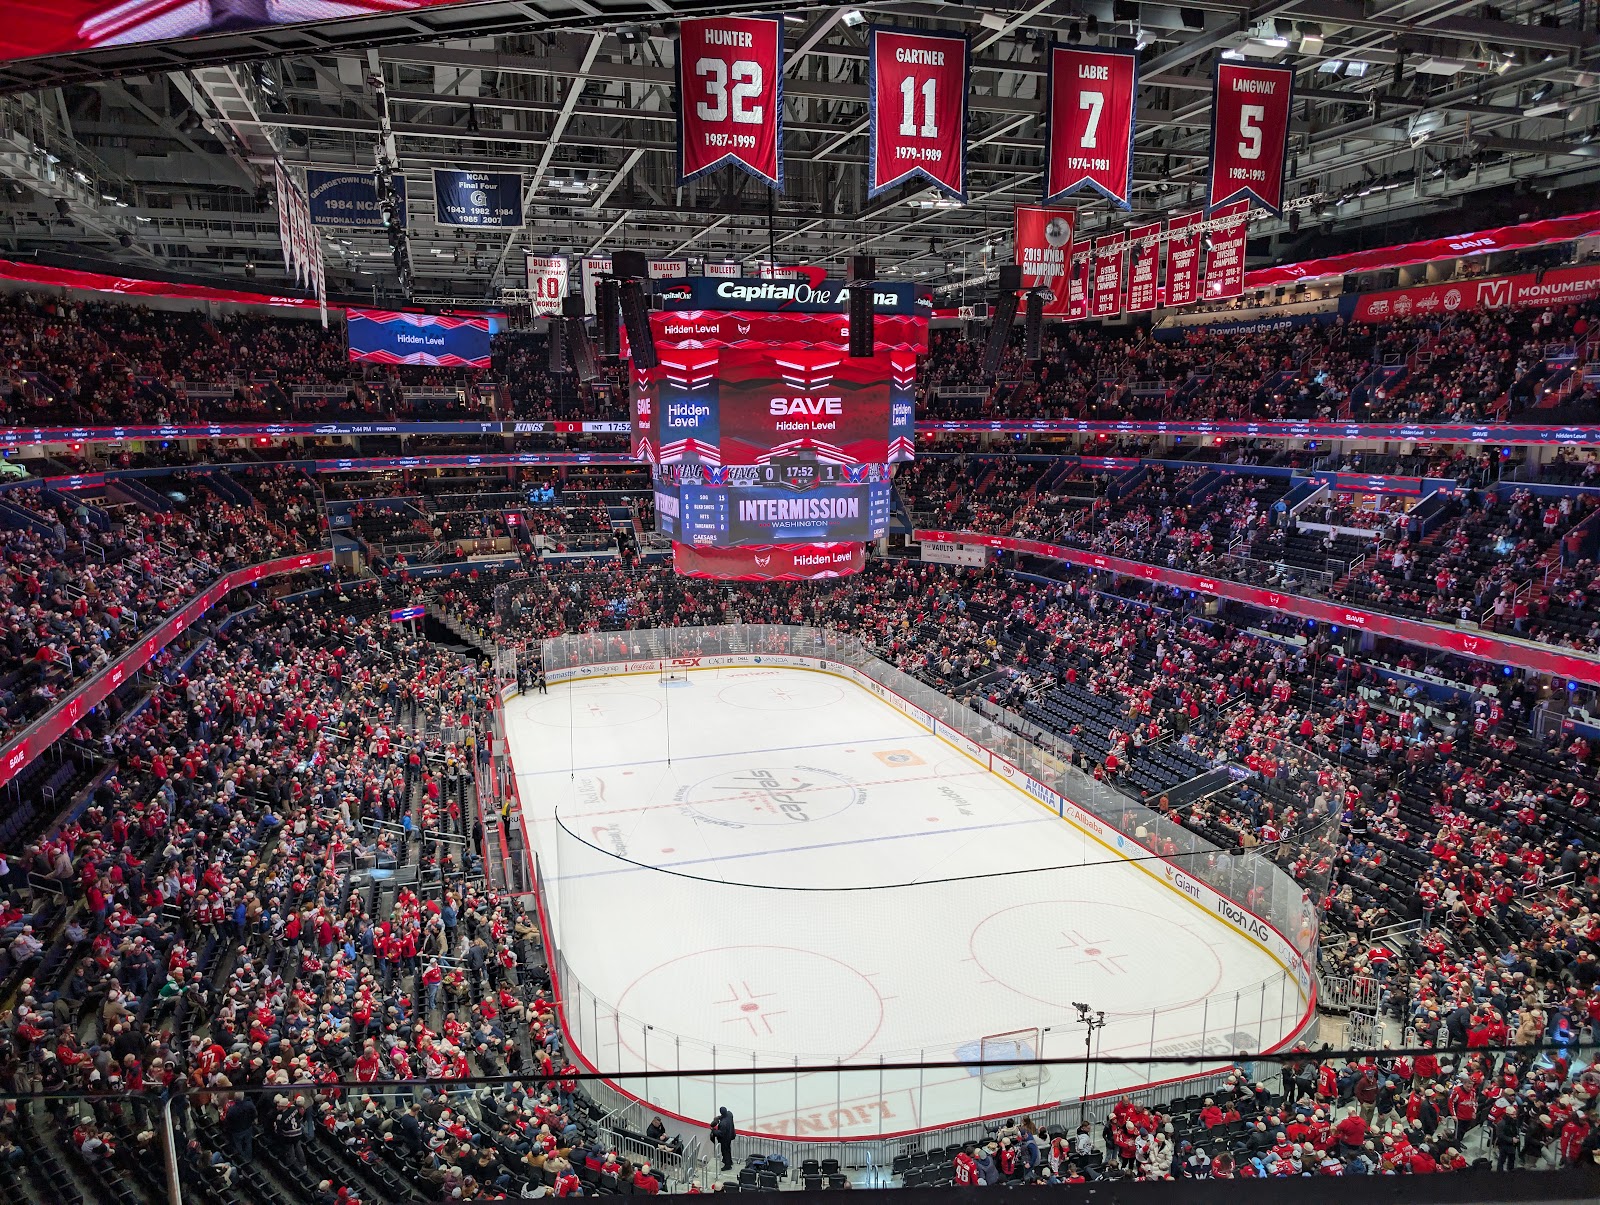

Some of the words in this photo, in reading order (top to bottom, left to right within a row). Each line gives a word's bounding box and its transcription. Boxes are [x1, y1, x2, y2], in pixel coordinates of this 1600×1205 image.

[705, 29, 752, 48] HUNTER
[896, 47, 945, 66] GARTNER
[1078, 64, 1108, 81] LABRE
[695, 57, 763, 124] 32
[1233, 77, 1276, 95] LANGWAY
[900, 76, 938, 138] 11
[1079, 91, 1105, 149] 7
[1238, 104, 1265, 160] 5
[704, 133, 755, 149] 1987-1999
[896, 147, 942, 162] 1979-1989
[1068, 157, 1110, 171] 1974-1981
[1229, 167, 1266, 181] 1982-1993
[310, 177, 360, 199] GEORGETOWN
[458, 181, 478, 189] Final
[480, 182, 498, 190] Four
[324, 200, 353, 209] 1984
[446, 205, 466, 214] 1943
[470, 207, 490, 215] 1982
[482, 215, 502, 224] 2007
[1448, 238, 1496, 252] SAVE
[1024, 248, 1042, 261] 2019
[1043, 248, 1064, 263] WNBA
[1212, 256, 1238, 268] CHAMPIONS
[533, 259, 561, 267] BULLETS
[588, 261, 613, 270] BULLET
[653, 263, 681, 272] BULLETS
[1023, 262, 1065, 276] CHAMPIONS
[710, 266, 735, 275] BULLETS
[536, 277, 559, 298] 10
[1518, 297, 1549, 306] SPORTS
[664, 324, 694, 335] Hidden
[695, 324, 719, 334] Level
[1209, 325, 1256, 336] Download
[1257, 325, 1271, 333] the
[1272, 321, 1292, 331] APP
[397, 334, 424, 344] Hidden
[425, 336, 444, 345] Level
[637, 398, 651, 414] SAVE
[668, 404, 710, 417] Hidden
[770, 397, 843, 415] SAVE
[893, 403, 911, 416] Hidden
[668, 416, 699, 427] Level
[776, 421, 810, 431] Hidden
[812, 421, 836, 430] Level
[893, 414, 907, 426] Level
[514, 423, 544, 432] KINGS
[608, 423, 631, 431] 17:52
[728, 465, 760, 480] KINGS
[765, 467, 773, 480] 0
[786, 467, 813, 477] 17:52
[826, 467, 834, 479] 1
[739, 498, 859, 521] INTERMISSION
[772, 520, 828, 528] WASHINGTON
[932, 544, 954, 552] VAULTS
[794, 554, 830, 566] Hidden
[833, 551, 852, 563] Level
[1346, 614, 1364, 624] SAVE
[9, 750, 25, 769] SAVE
[1025, 778, 1055, 808] AKIMA
[1075, 811, 1103, 835] Alibaba
[1175, 872, 1201, 899] Giant
[1218, 898, 1247, 929] iTech
[1248, 920, 1269, 942] AG
[201, 1052, 216, 1068] 77
[1320, 1132, 1327, 1143] 8
[955, 1166, 969, 1183] 48
